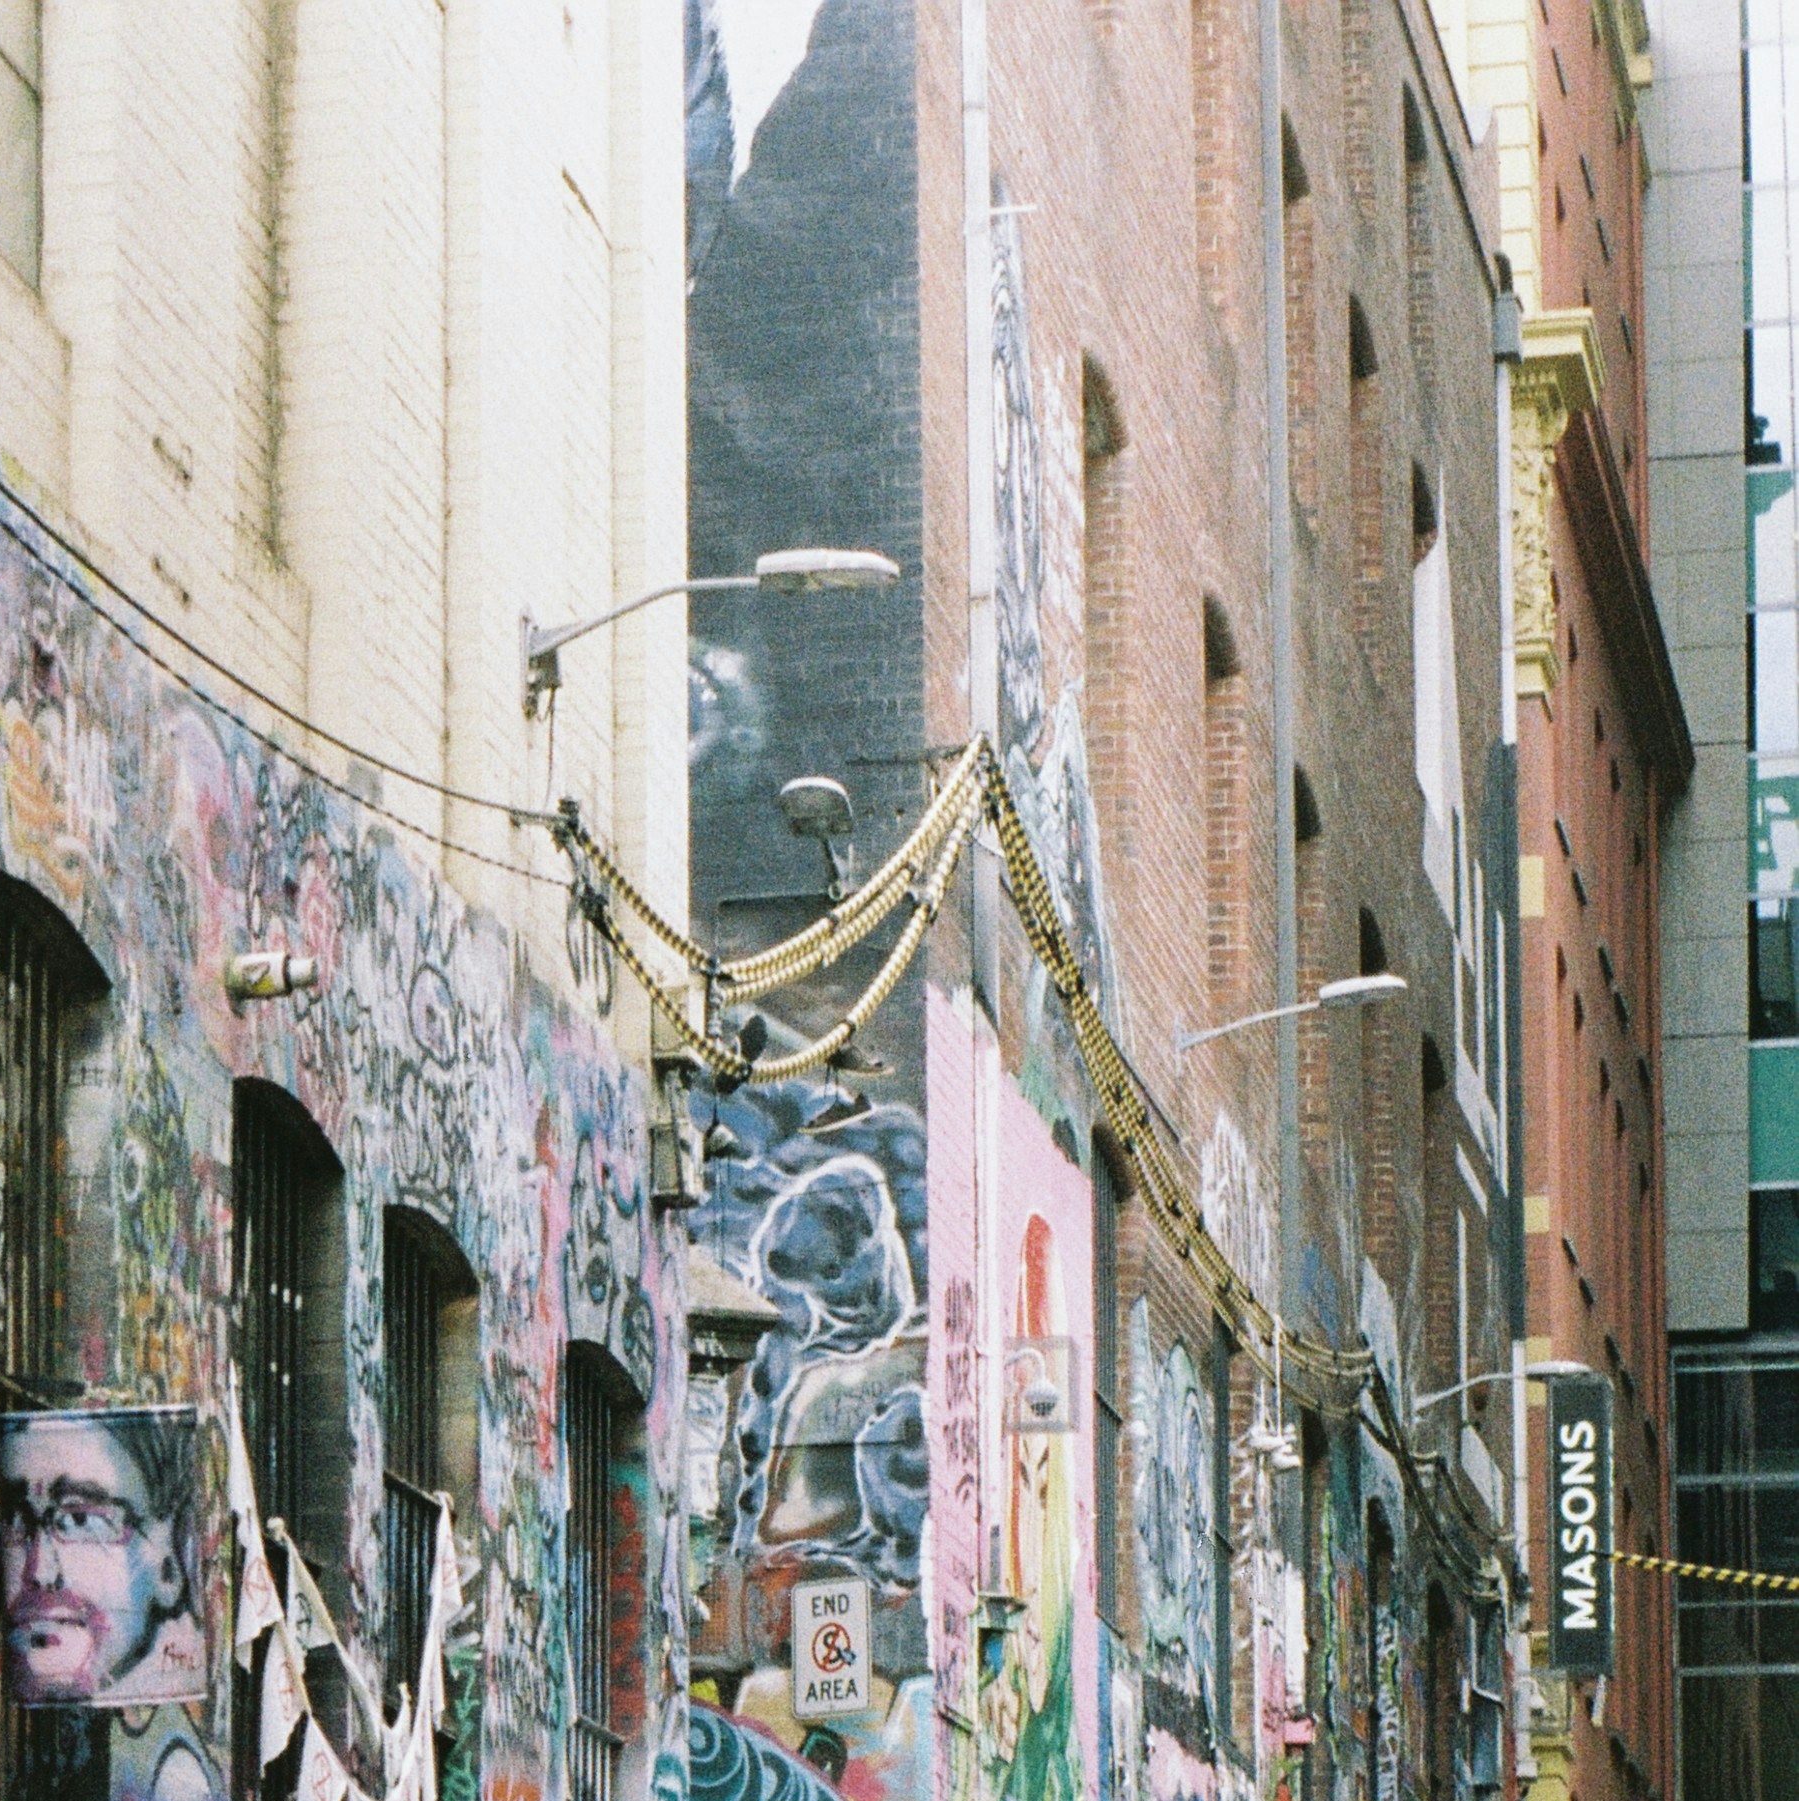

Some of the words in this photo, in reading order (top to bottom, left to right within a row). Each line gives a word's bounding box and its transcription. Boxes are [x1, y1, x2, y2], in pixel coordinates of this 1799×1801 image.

[1560, 1420, 1597, 1630] MASONS
[811, 1594, 850, 1618] END
[806, 1678, 858, 1702] AREA
